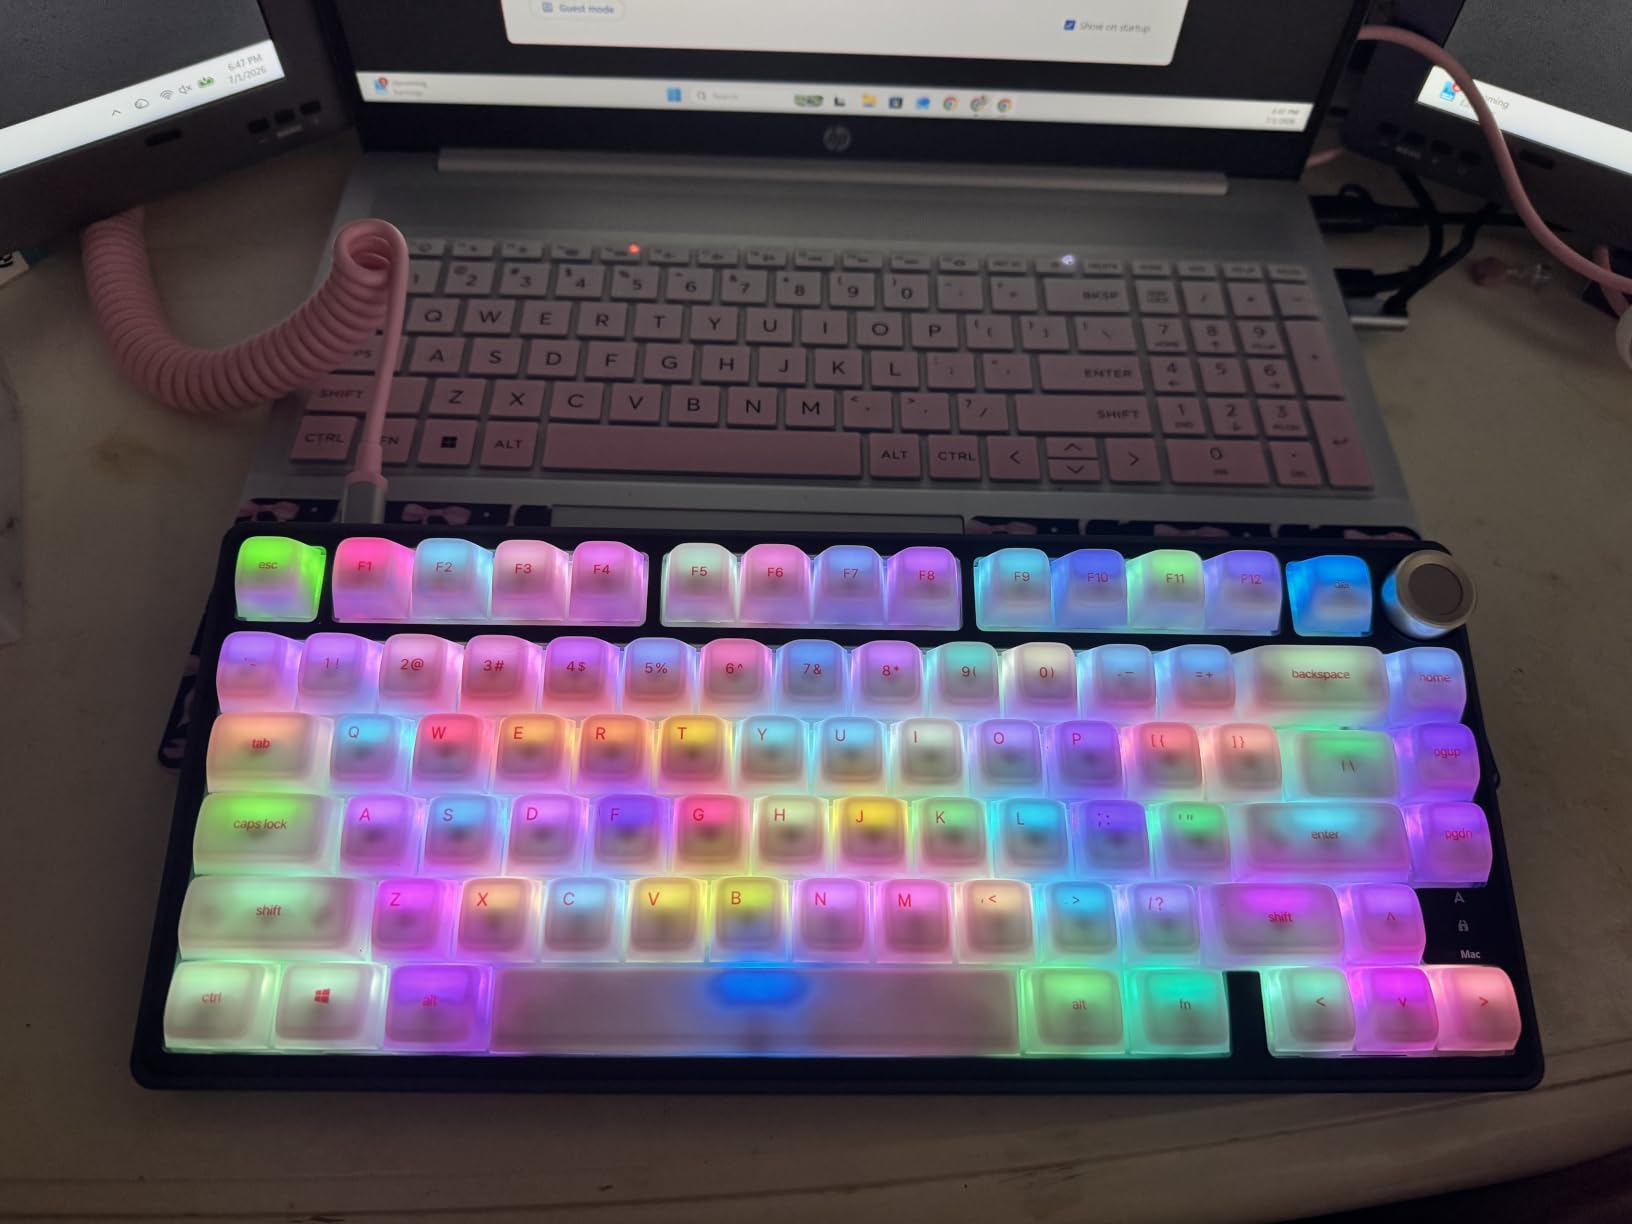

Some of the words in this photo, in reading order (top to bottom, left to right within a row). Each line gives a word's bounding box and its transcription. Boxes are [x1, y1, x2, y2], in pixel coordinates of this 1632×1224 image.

[247, 53, 263, 65] PM
[424, 309, 443, 323] Q
[479, 311, 502, 323] W
[539, 312, 553, 326] E
[595, 313, 609, 327] R
[653, 315, 666, 328] T
[707, 317, 721, 331] Y
[762, 319, 778, 333] U
[871, 322, 889, 336] O
[928, 323, 942, 337] P
[1158, 324, 1169, 335] 7
[1206, 325, 1217, 337] 8
[1253, 325, 1266, 338] 9
[428, 349, 445, 362] A
[489, 351, 502, 364] S
[545, 352, 562, 366] D
[605, 353, 619, 367] F
[661, 355, 678, 370] G
[719, 357, 735, 371] H
[777, 359, 789, 373] J
[832, 360, 846, 375] K
[889, 362, 902, 376] L
[1166, 362, 1177, 374] 4
[1216, 362, 1228, 376] 5
[1083, 368, 1133, 379] ENTER
[1263, 364, 1277, 377] 6
[319, 389, 364, 400] SHIFT
[448, 389, 465, 404] Z
[508, 392, 525, 407] X
[567, 394, 585, 408] C
[628, 395, 644, 410] V
[687, 398, 701, 412] B
[745, 400, 762, 414] N
[801, 401, 821, 416] M
[1096, 409, 1140, 420] SHIFT
[1177, 403, 1186, 416] 1
[1225, 404, 1238, 418] 2
[1276, 404, 1288, 418] 3
[304, 433, 345, 444] CTRL
[494, 439, 524, 449] ALT
[880, 450, 909, 460] ALT
[937, 451, 976, 462] CTRL
[1209, 447, 1223, 461] 0
[258, 561, 278, 570] esc
[357, 561, 372, 572] F1
[436, 562, 453, 573] F2
[515, 564, 532, 574] F3
[593, 564, 610, 575] F4
[691, 566, 708, 577] F5
[767, 567, 784, 578] F6
[843, 569, 858, 579] F7
[919, 570, 935, 581] F8
[1014, 571, 1031, 582] F9
[1087, 572, 1109, 583] F10
[1166, 573, 1185, 584] F11
[1241, 574, 1262, 585] F12
[324, 657, 340, 669] 1!
[400, 658, 425, 671] 2@
[483, 660, 505, 672] 3#
[566, 661, 586, 673] 4$
[644, 662, 668, 674] 5%
[803, 663, 822, 675] 7&
[1292, 669, 1351, 681] backspace
[348, 726, 360, 739] Q
[432, 726, 447, 739] W
[514, 726, 524, 740] E
[595, 726, 606, 740] R
[677, 727, 687, 740] T
[757, 728, 768, 741] Y
[835, 729, 846, 742] U
[993, 731, 1005, 745] O
[1072, 732, 1082, 745] P
[251, 738, 271, 750] tab
[360, 808, 371, 821] A
[443, 808, 454, 822] S
[526, 807, 538, 821] D
[610, 808, 620, 821] F
[692, 808, 705, 821] G
[774, 808, 785, 822] H
[855, 810, 864, 823] J
[936, 811, 946, 824] K
[1016, 812, 1025, 825] L
[233, 819, 262, 831] caps
[264, 819, 287, 830] lock
[1311, 830, 1340, 840] enter
[390, 893, 401, 907] Z
[477, 892, 489, 907] X
[563, 892, 575, 906] C
[648, 892, 660, 906] V
[731, 891, 741, 905] B
[815, 892, 826, 906] N
[898, 894, 912, 907] M
[256, 905, 282, 916] shift
[1268, 911, 1293, 923] shift
[1460, 950, 1481, 959] Mac
[1072, 1000, 1087, 1010] alt
